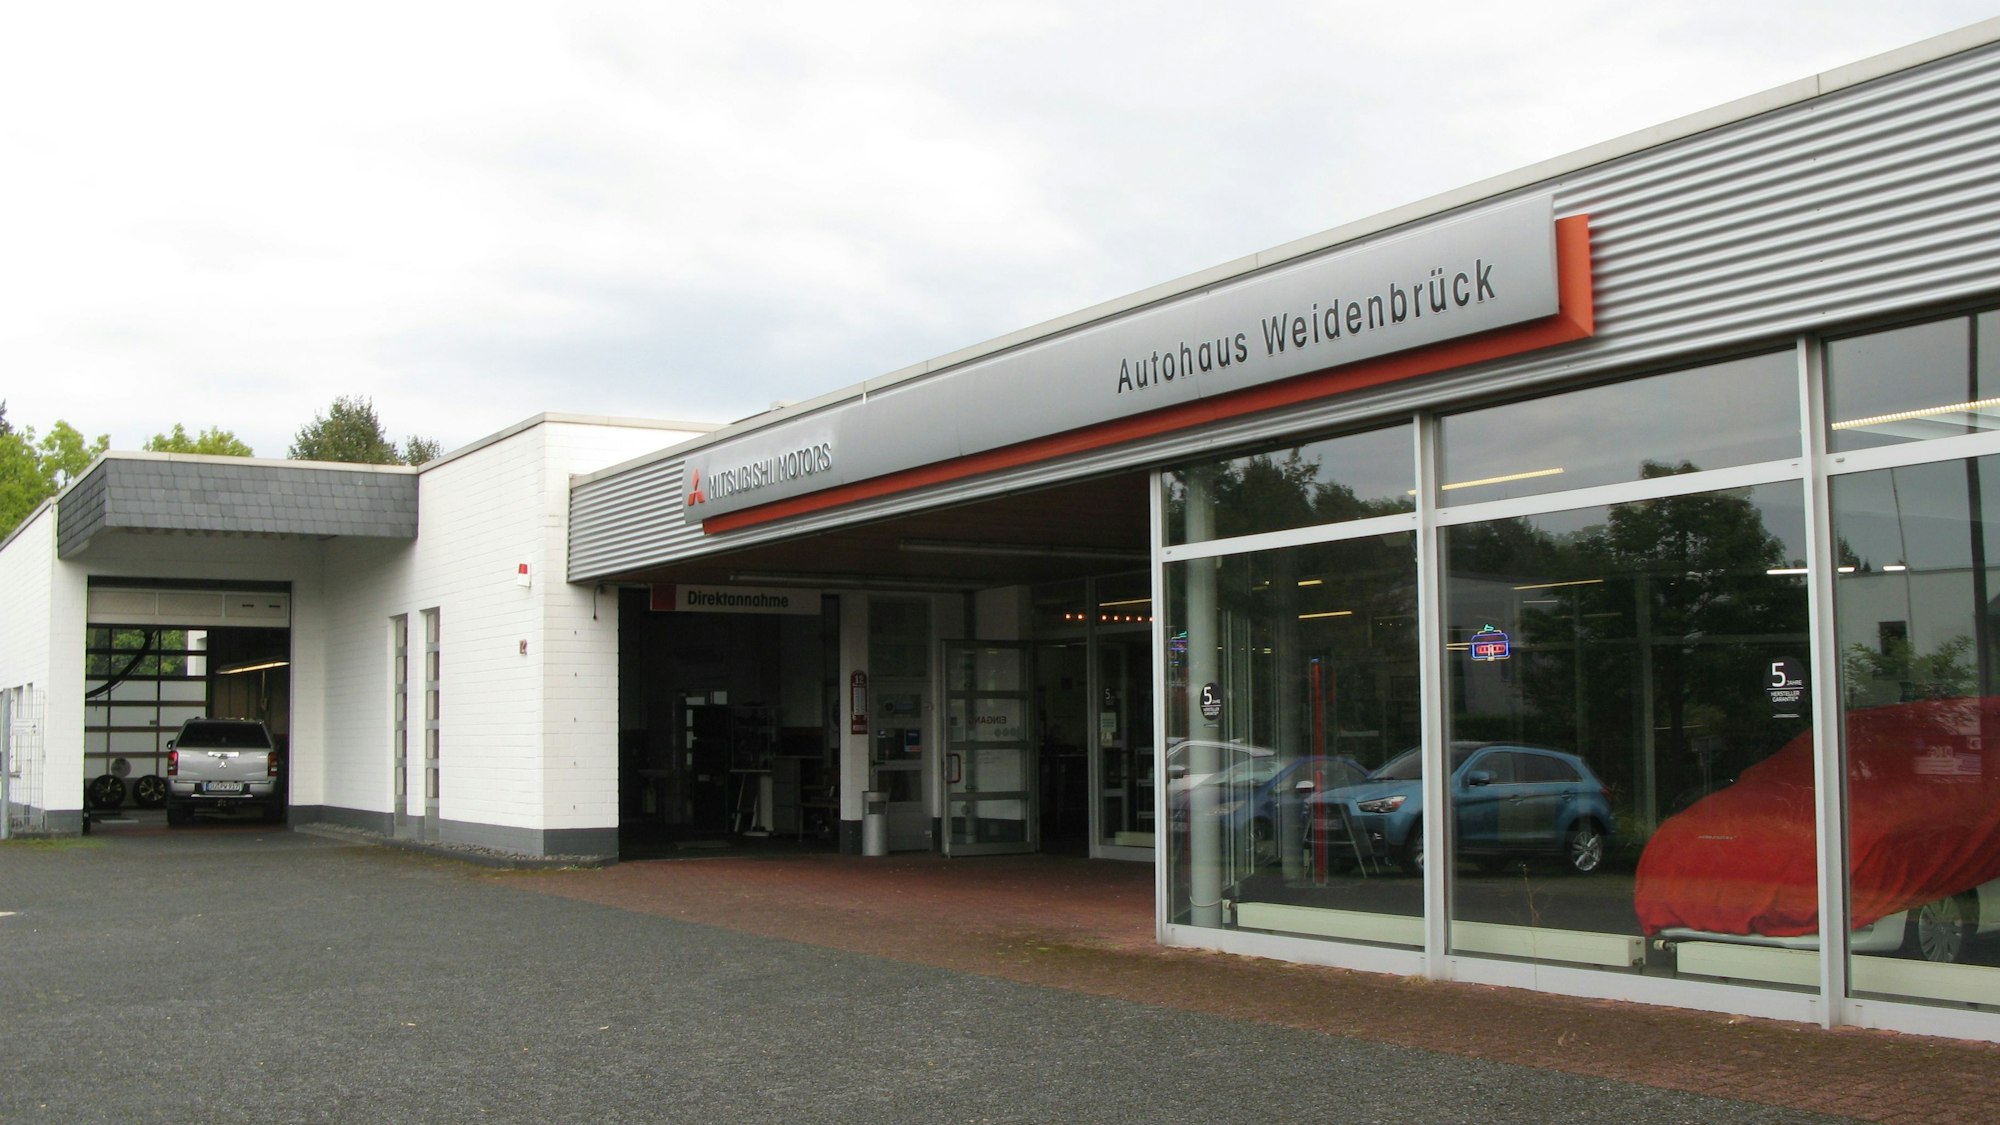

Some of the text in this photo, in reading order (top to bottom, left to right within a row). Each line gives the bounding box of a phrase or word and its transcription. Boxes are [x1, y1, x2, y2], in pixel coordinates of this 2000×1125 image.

[1117, 259, 1496, 394] Autohaus Weidenbrück
[708, 443, 832, 500] MITSUBISHI MOTORS
[687, 590, 789, 609] Direktannahme
[1772, 662, 1786, 687] 5
[1203, 686, 1212, 704] 5
